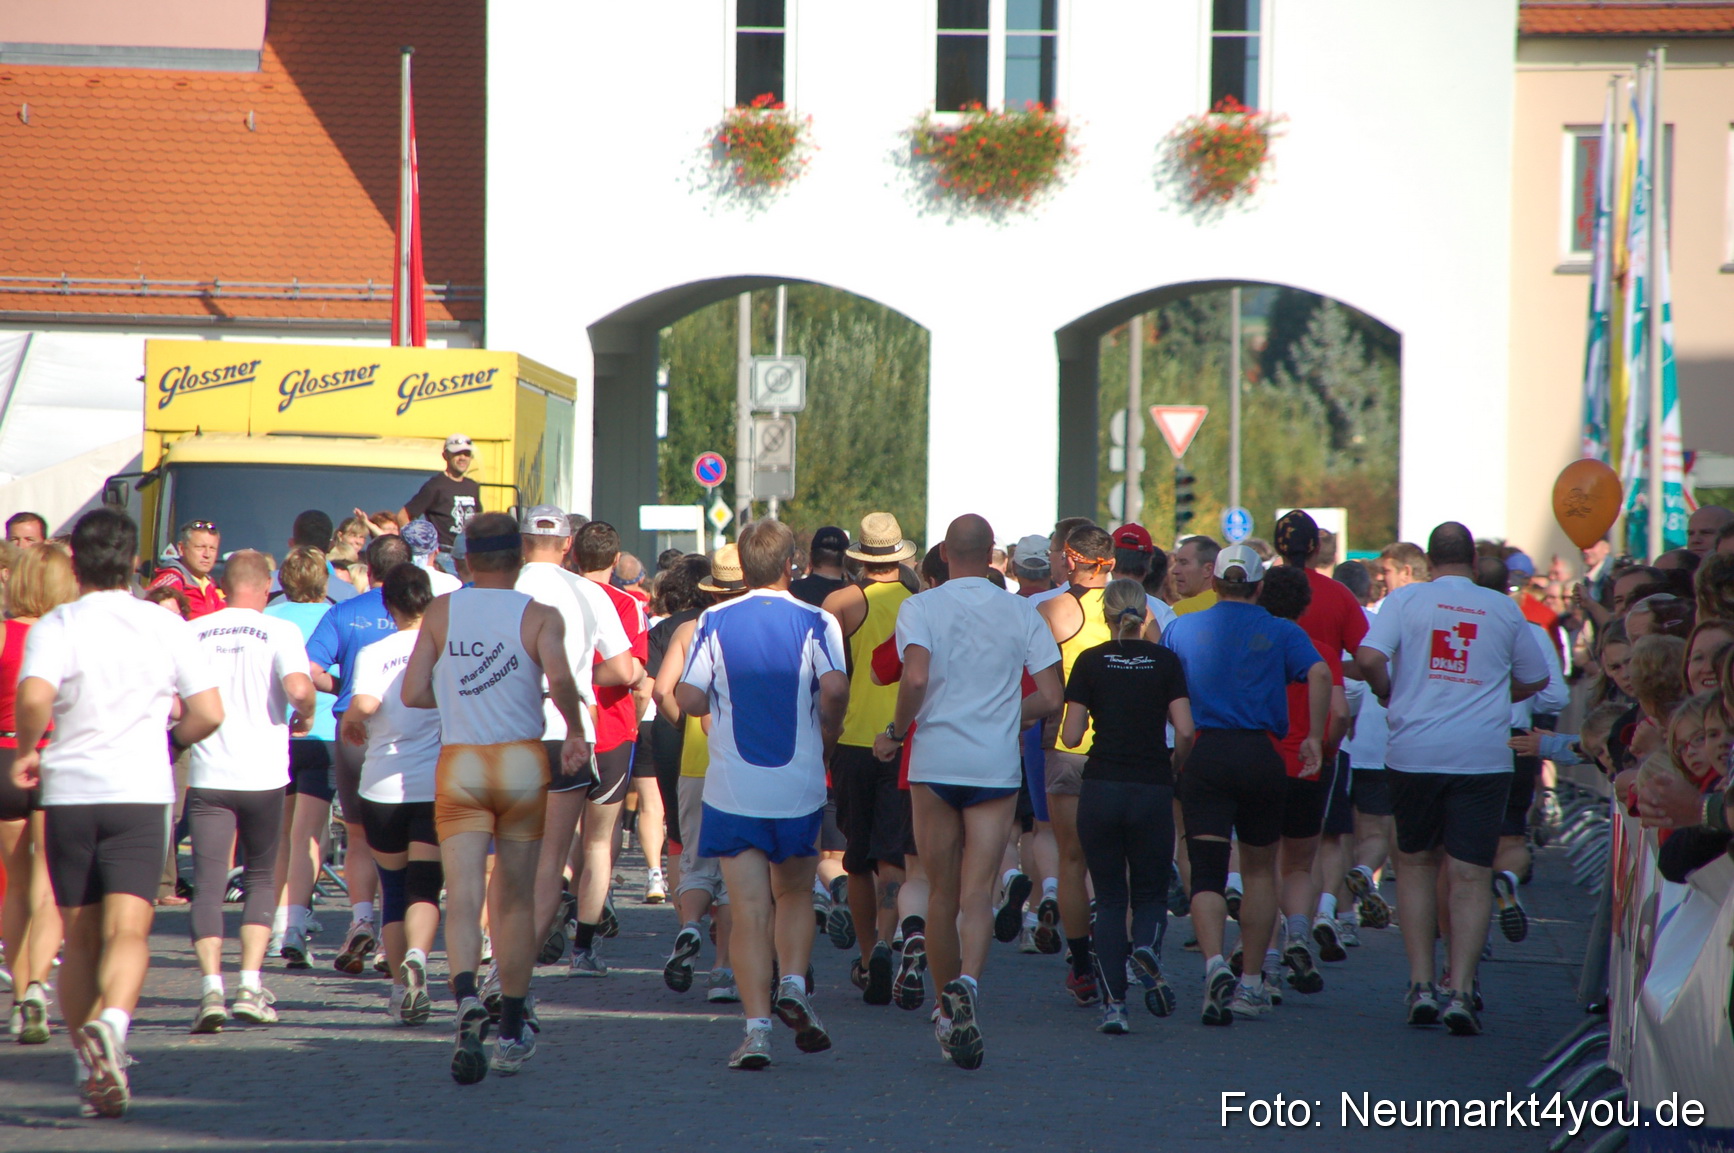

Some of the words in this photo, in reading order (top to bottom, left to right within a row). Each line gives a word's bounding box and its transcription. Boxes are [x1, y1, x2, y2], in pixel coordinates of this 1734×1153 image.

[158, 360, 262, 410] Glossner
[278, 364, 380, 413] Glossner
[396, 368, 499, 416] Glossner
[449, 641, 485, 658] LLC
[459, 641, 506, 687] Marathon
[1431, 657, 1466, 673] DKMS
[458, 653, 520, 697] Regensburg
